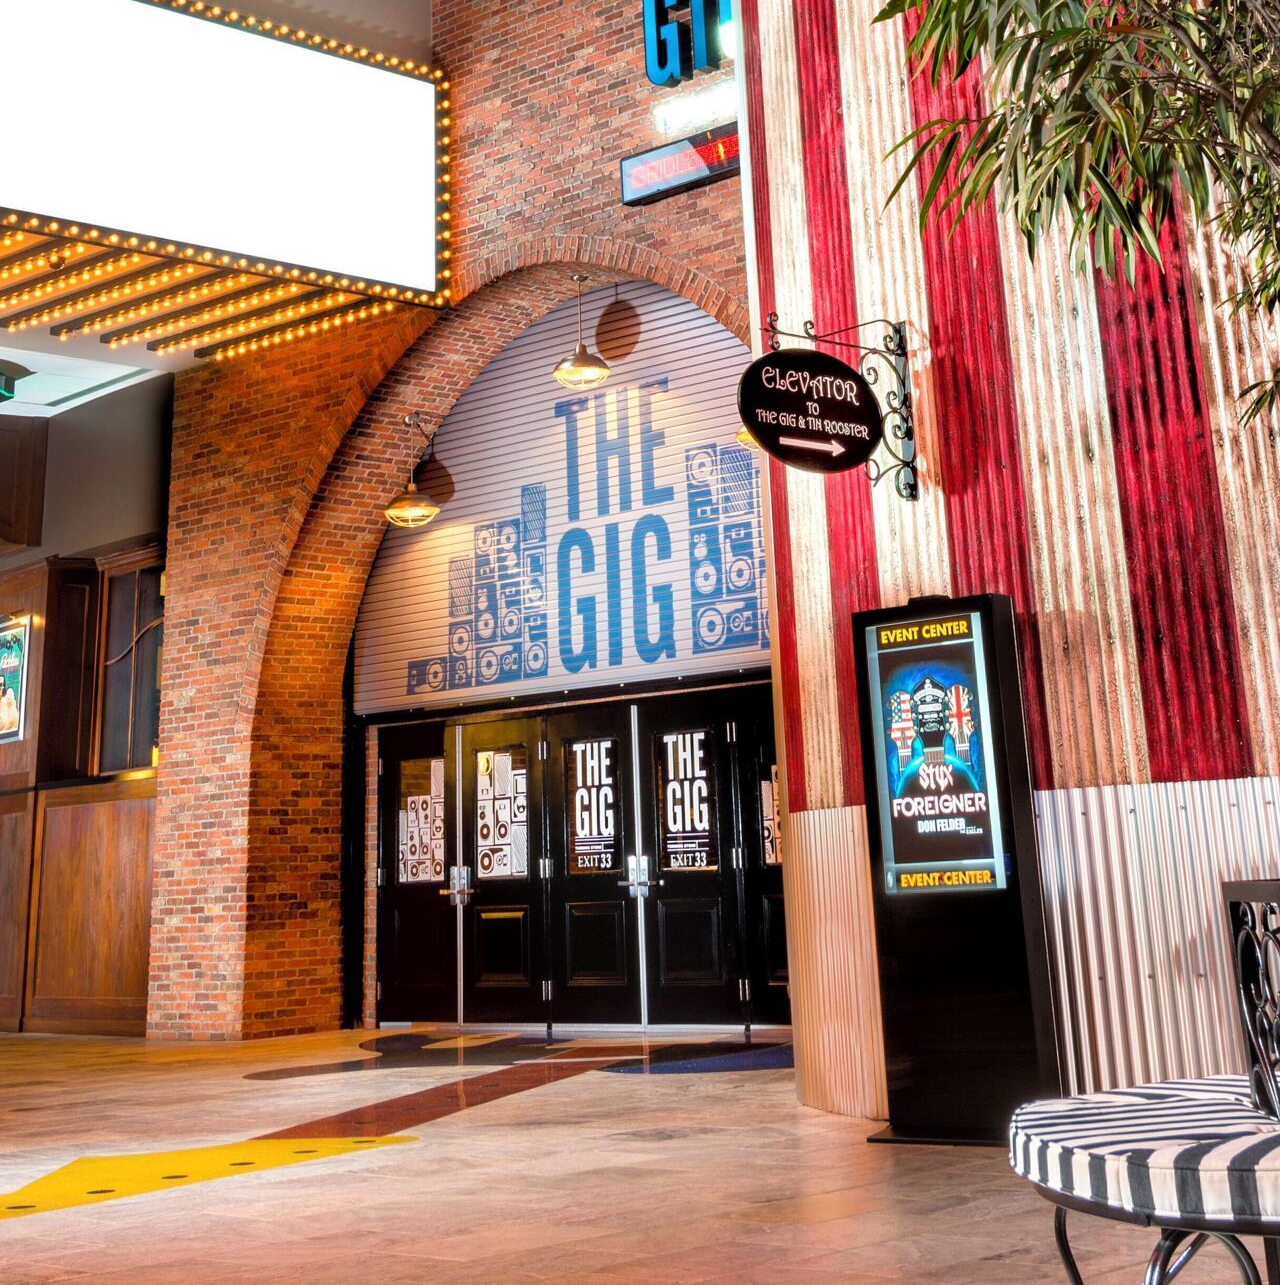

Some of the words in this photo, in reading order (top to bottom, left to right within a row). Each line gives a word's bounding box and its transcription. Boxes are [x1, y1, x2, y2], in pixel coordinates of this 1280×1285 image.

[761, 366, 860, 406] ELEVATOR
[756, 408, 778, 424] THE
[779, 412, 797, 429] GIG
[798, 416, 806, 429] &
[806, 416, 822, 432] TIN
[823, 419, 870, 441] ROOSTER
[806, 401, 820, 416] TO
[554, 375, 676, 523] THE
[556, 513, 678, 675] GIG
[880, 626, 919, 644] EVENT
[921, 620, 969, 639] CENTER
[572, 740, 613, 787] THE
[663, 732, 707, 780] THE
[575, 786, 615, 837] GIG
[666, 779, 710, 833] GIG
[892, 792, 987, 818] FOREIGNER
[917, 819, 936, 834] DON
[936, 817, 966, 832] FELDER
[577, 854, 600, 868] EXIT
[600, 853, 612, 868] 33
[670, 853, 694, 867] EXIT
[694, 851, 707, 867] 33
[900, 872, 941, 888] EVENT
[943, 869, 993, 885] CENTER
